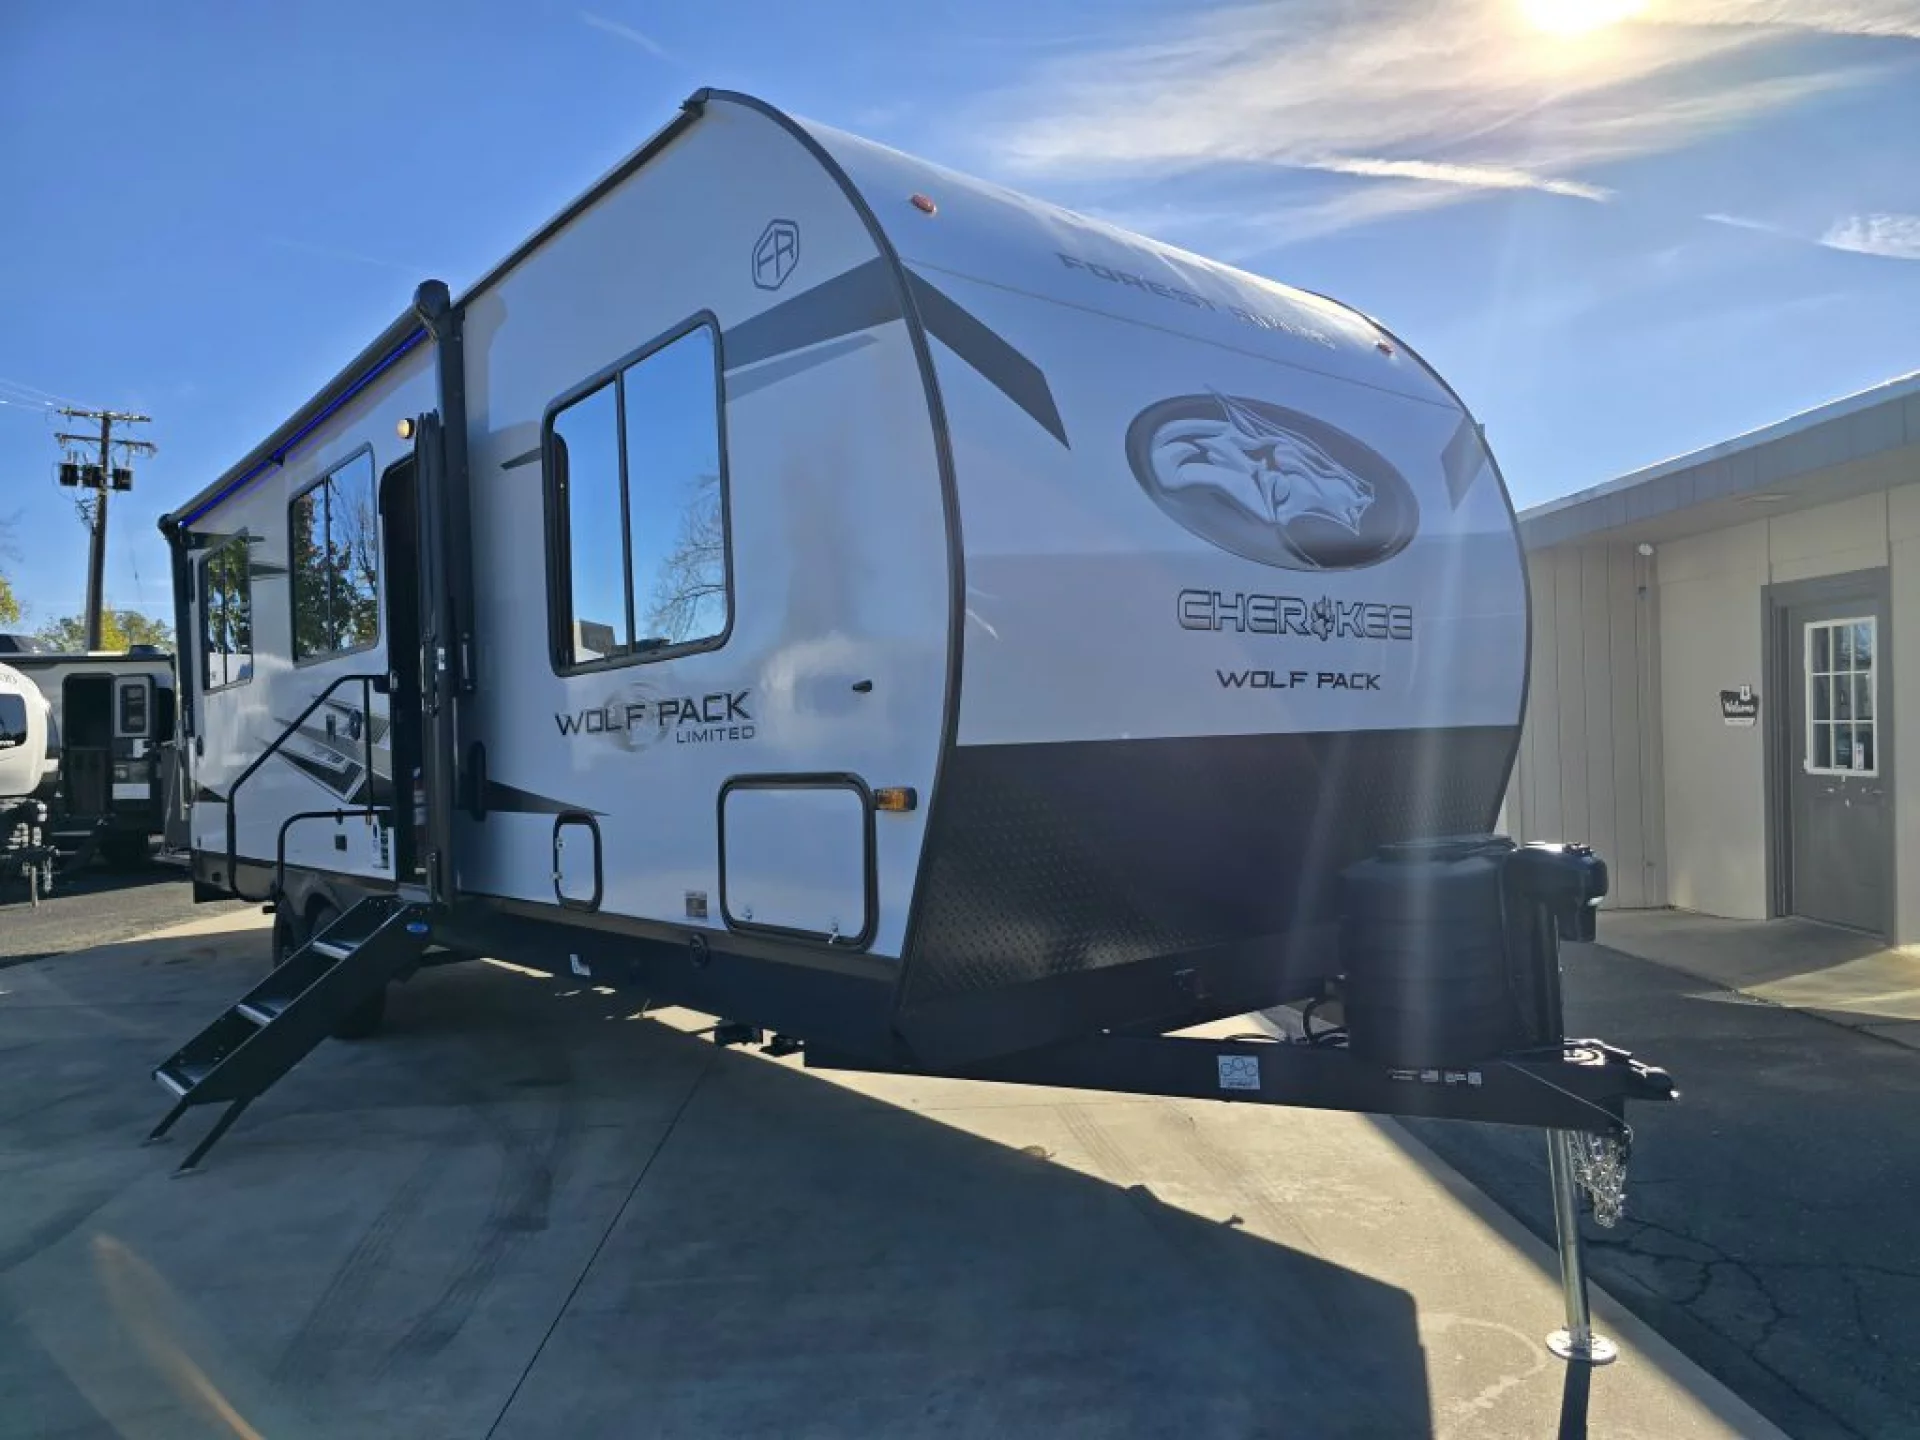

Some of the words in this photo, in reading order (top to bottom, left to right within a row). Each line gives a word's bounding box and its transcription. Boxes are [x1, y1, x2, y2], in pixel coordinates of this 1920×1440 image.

[1216, 669, 1307, 689] WOLF
[1317, 672, 1381, 690] PACK
[555, 704, 645, 736] WOLF
[657, 690, 752, 726] PACK
[676, 725, 755, 743] LIMITED
